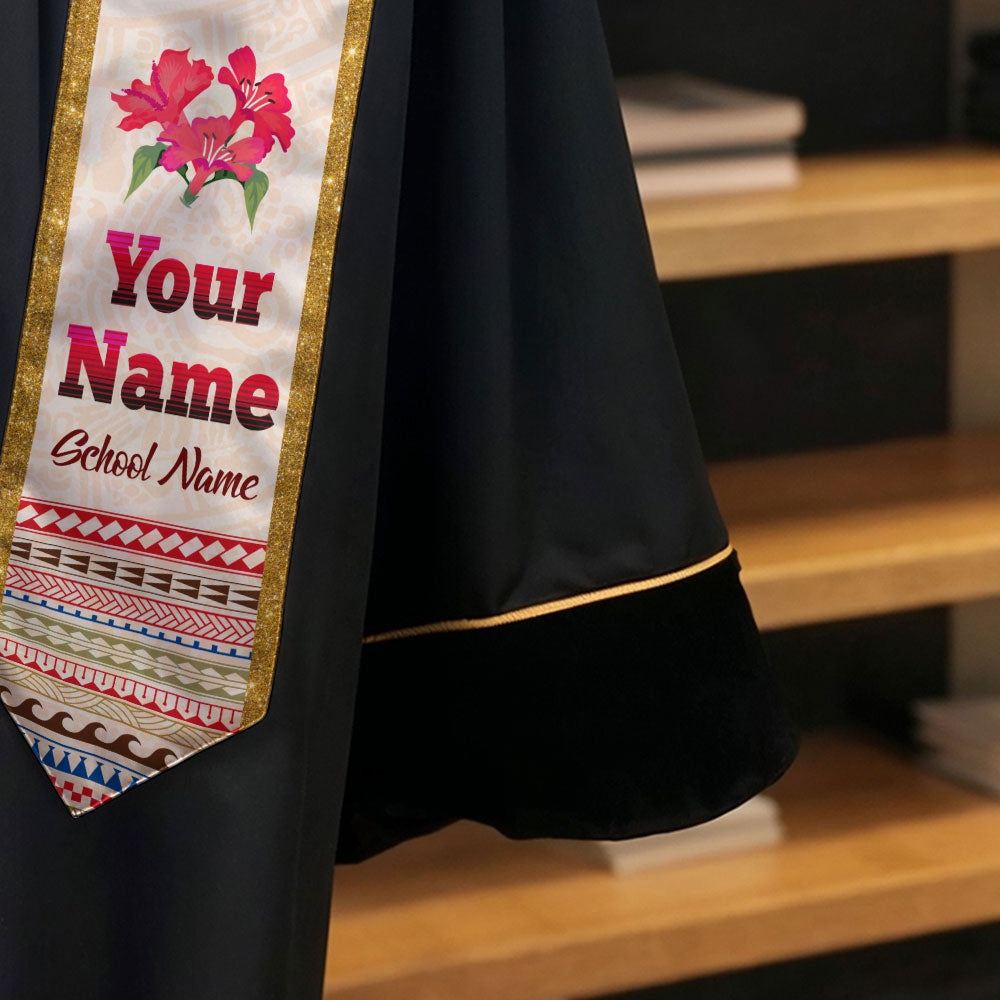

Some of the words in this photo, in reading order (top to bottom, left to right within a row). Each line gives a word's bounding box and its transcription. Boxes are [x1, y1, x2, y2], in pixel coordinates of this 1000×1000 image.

[105, 229, 276, 327] Your
[57, 323, 280, 431] Name
[50, 428, 159, 481] School
[157, 446, 259, 500] Name
